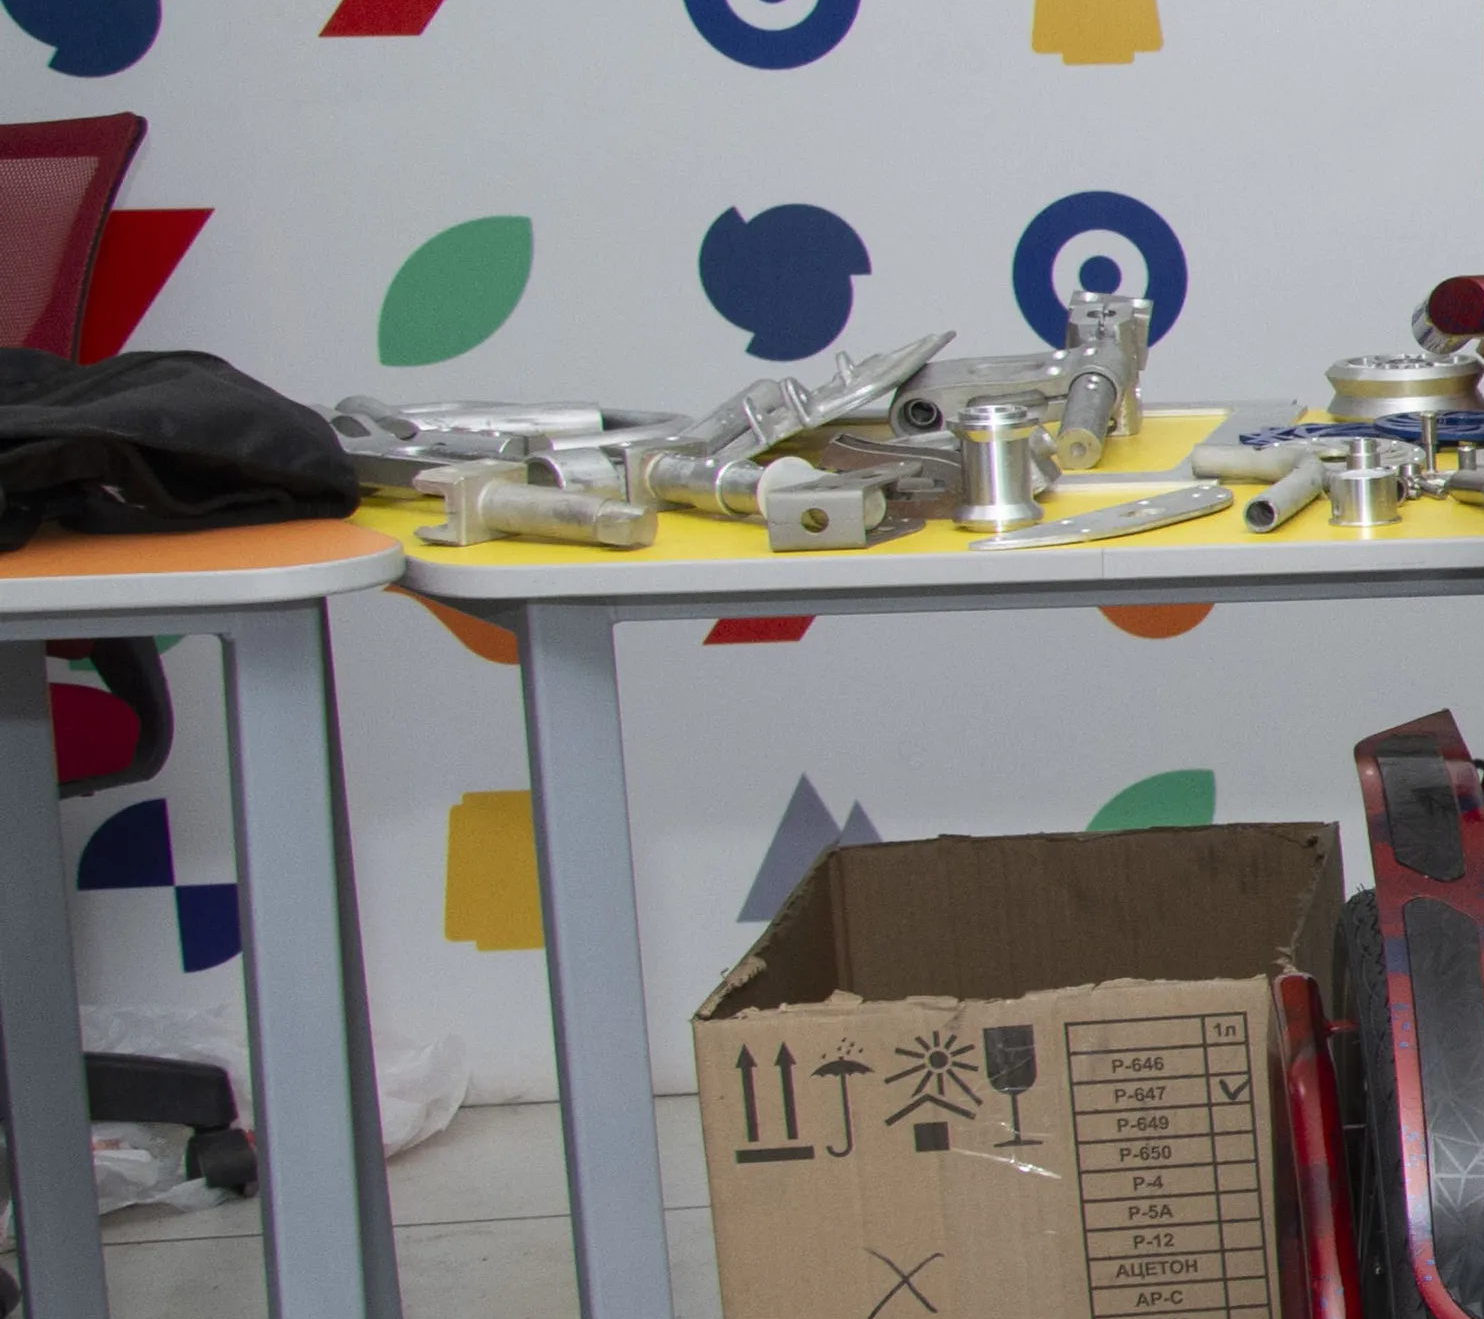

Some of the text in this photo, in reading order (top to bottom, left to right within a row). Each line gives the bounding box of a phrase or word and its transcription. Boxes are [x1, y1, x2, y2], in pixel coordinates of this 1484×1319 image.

[1213, 1022, 1236, 1038] 1л
[1111, 1056, 1165, 1074] Р-646
[1114, 1085, 1167, 1103] Р-647
[1116, 1115, 1169, 1133] Р-649
[1119, 1145, 1172, 1162] Р-650
[1132, 1175, 1164, 1192] Р-4
[1128, 1204, 1174, 1221] Р-5А
[1133, 1233, 1175, 1250] Р-12
[1115, 1258, 1198, 1281] АЦЕТОН
[1135, 1290, 1184, 1308] АР-С
